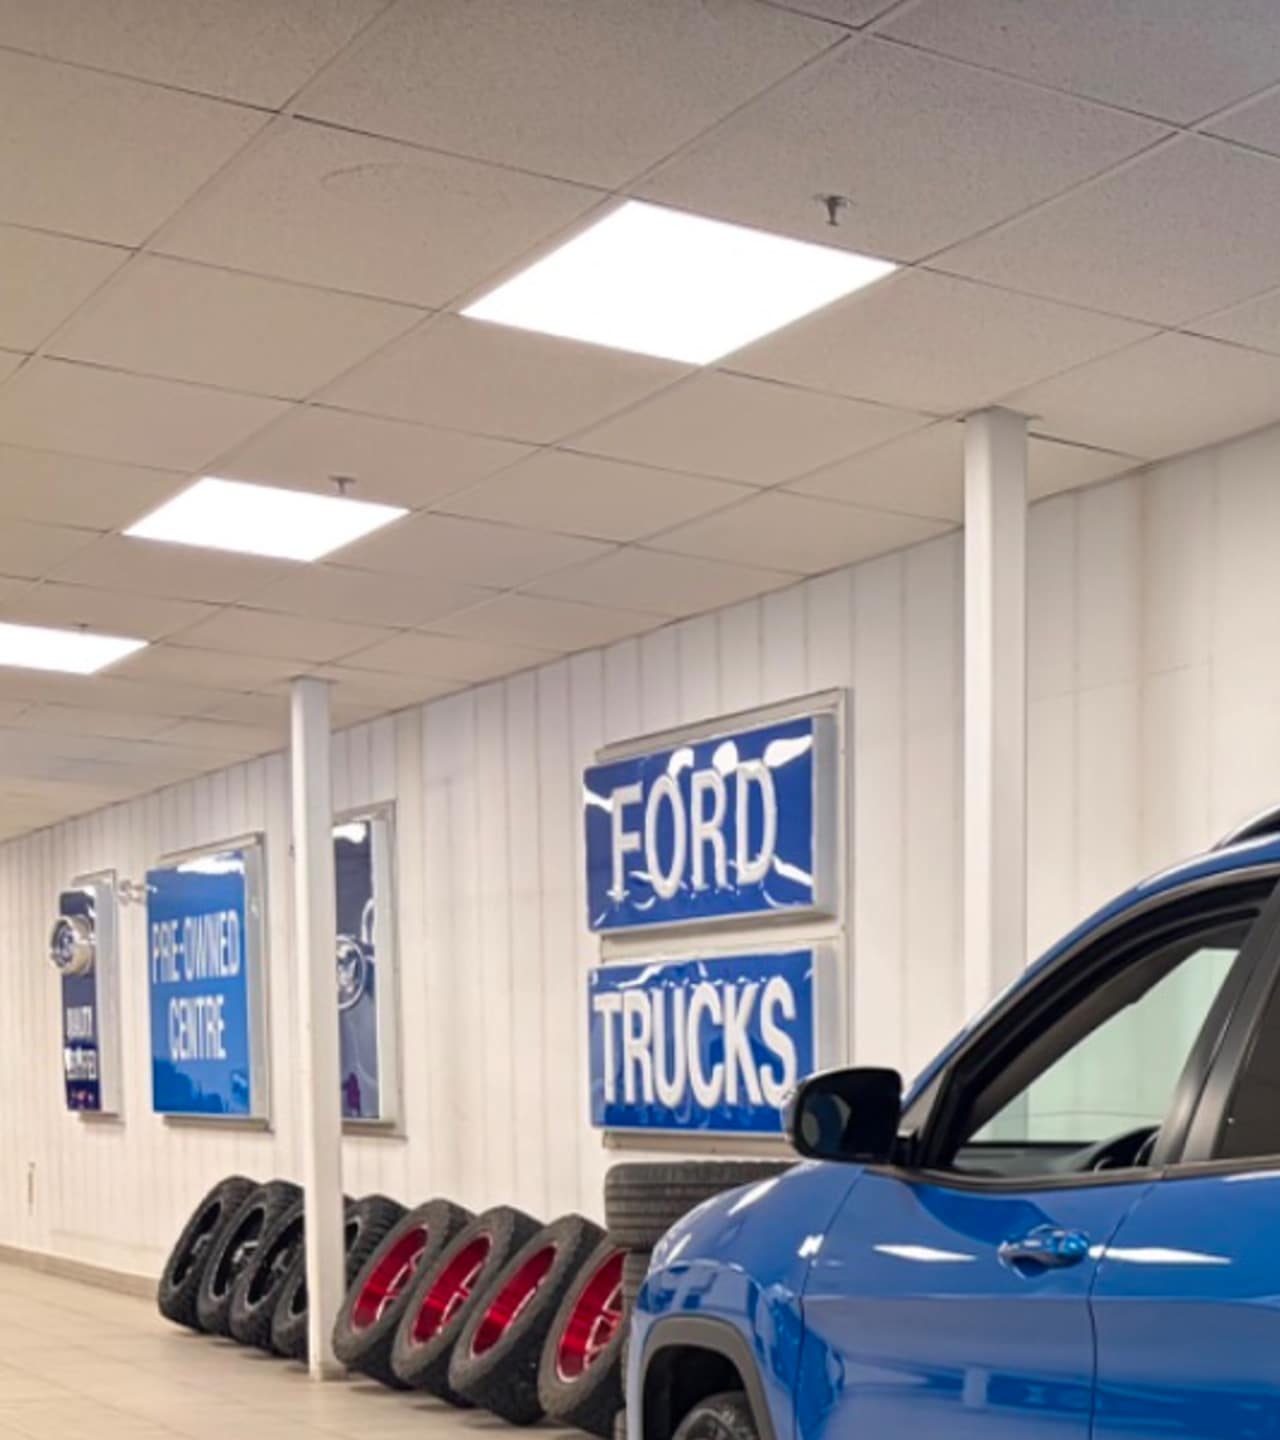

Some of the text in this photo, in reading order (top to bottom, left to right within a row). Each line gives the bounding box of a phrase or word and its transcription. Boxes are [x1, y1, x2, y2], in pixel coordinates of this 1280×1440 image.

[609, 757, 778, 905] FORD
[152, 908, 241, 984] PRE-OWNED
[167, 994, 228, 1062] CENTRE
[593, 975, 798, 1110] TRUCKS
